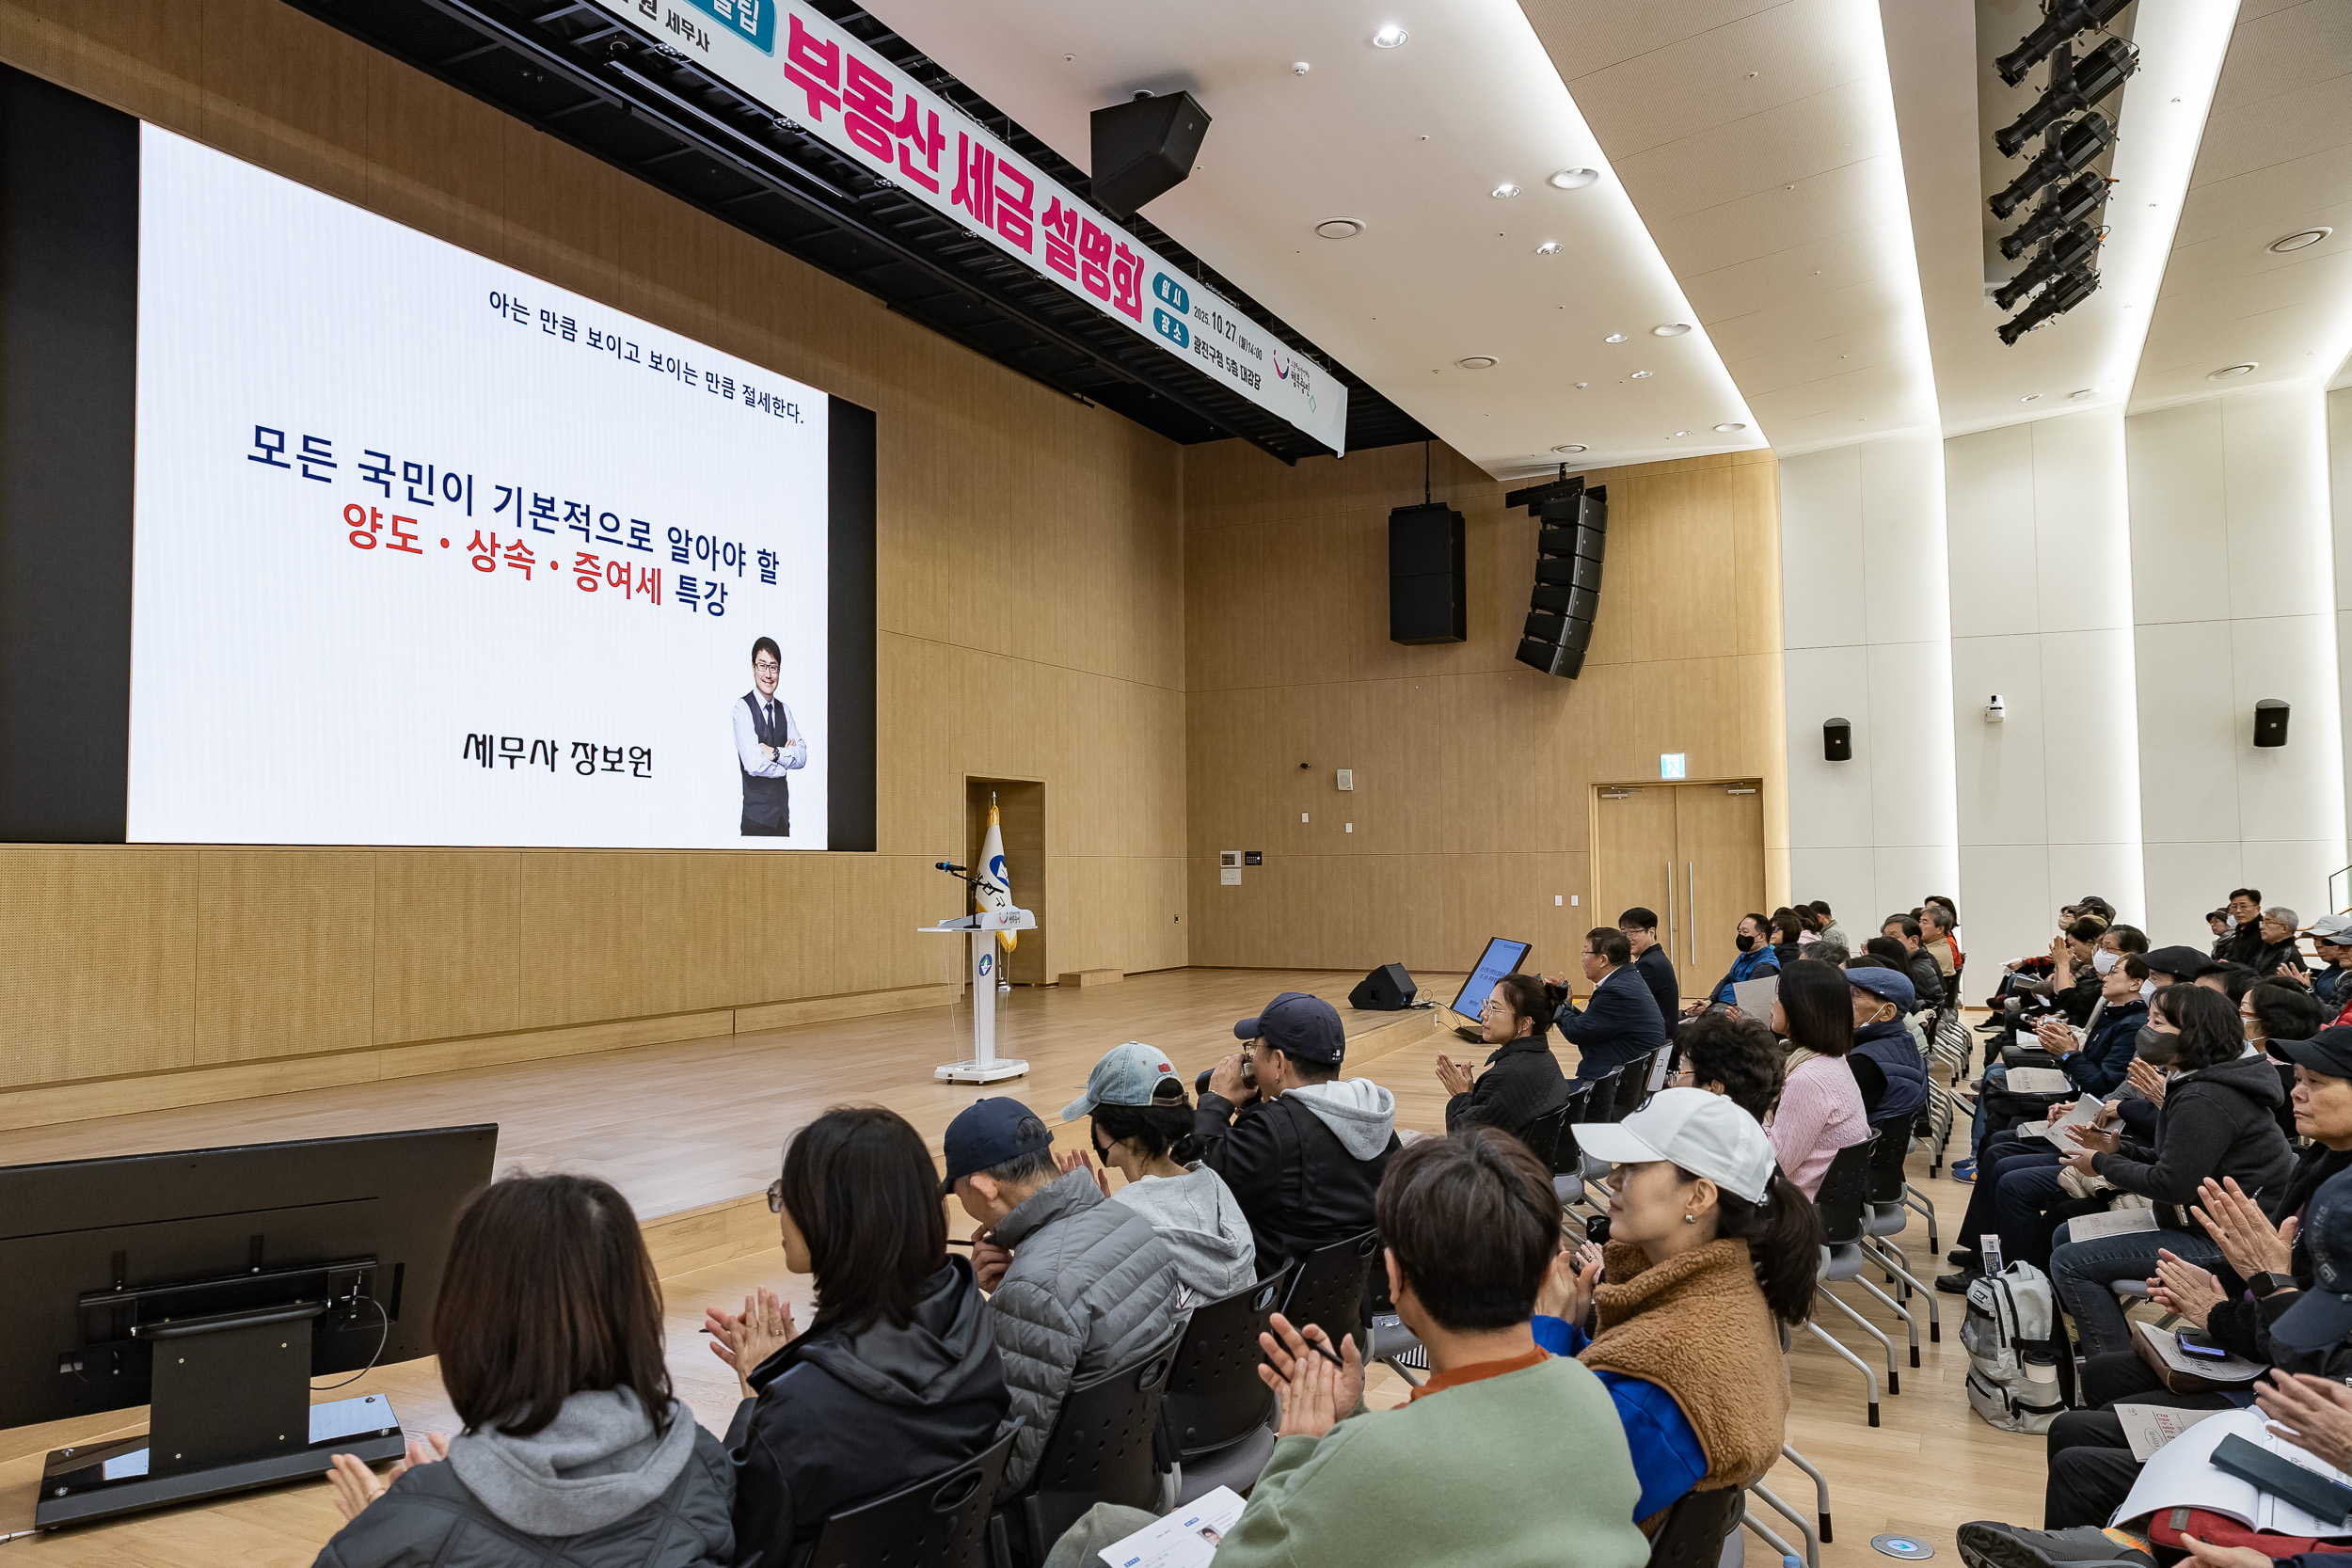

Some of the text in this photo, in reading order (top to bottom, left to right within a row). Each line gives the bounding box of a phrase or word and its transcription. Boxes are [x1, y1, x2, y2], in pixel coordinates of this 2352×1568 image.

[664, 8, 711, 54] 세무사
[784, 13, 1144, 323] 부동산 세금 설명회
[489, 291, 805, 425] 아는 만큼 보이고 보이는 만큼 절세한다.
[1194, 335, 1224, 370] 광진구청
[1226, 356, 1239, 378] 5층
[1240, 363, 1262, 391] 대강당
[246, 424, 780, 587] 모든 국민이 기본적으로 알아야 할
[675, 574, 728, 618] 특강
[463, 733, 652, 779] 세무사 장보원
